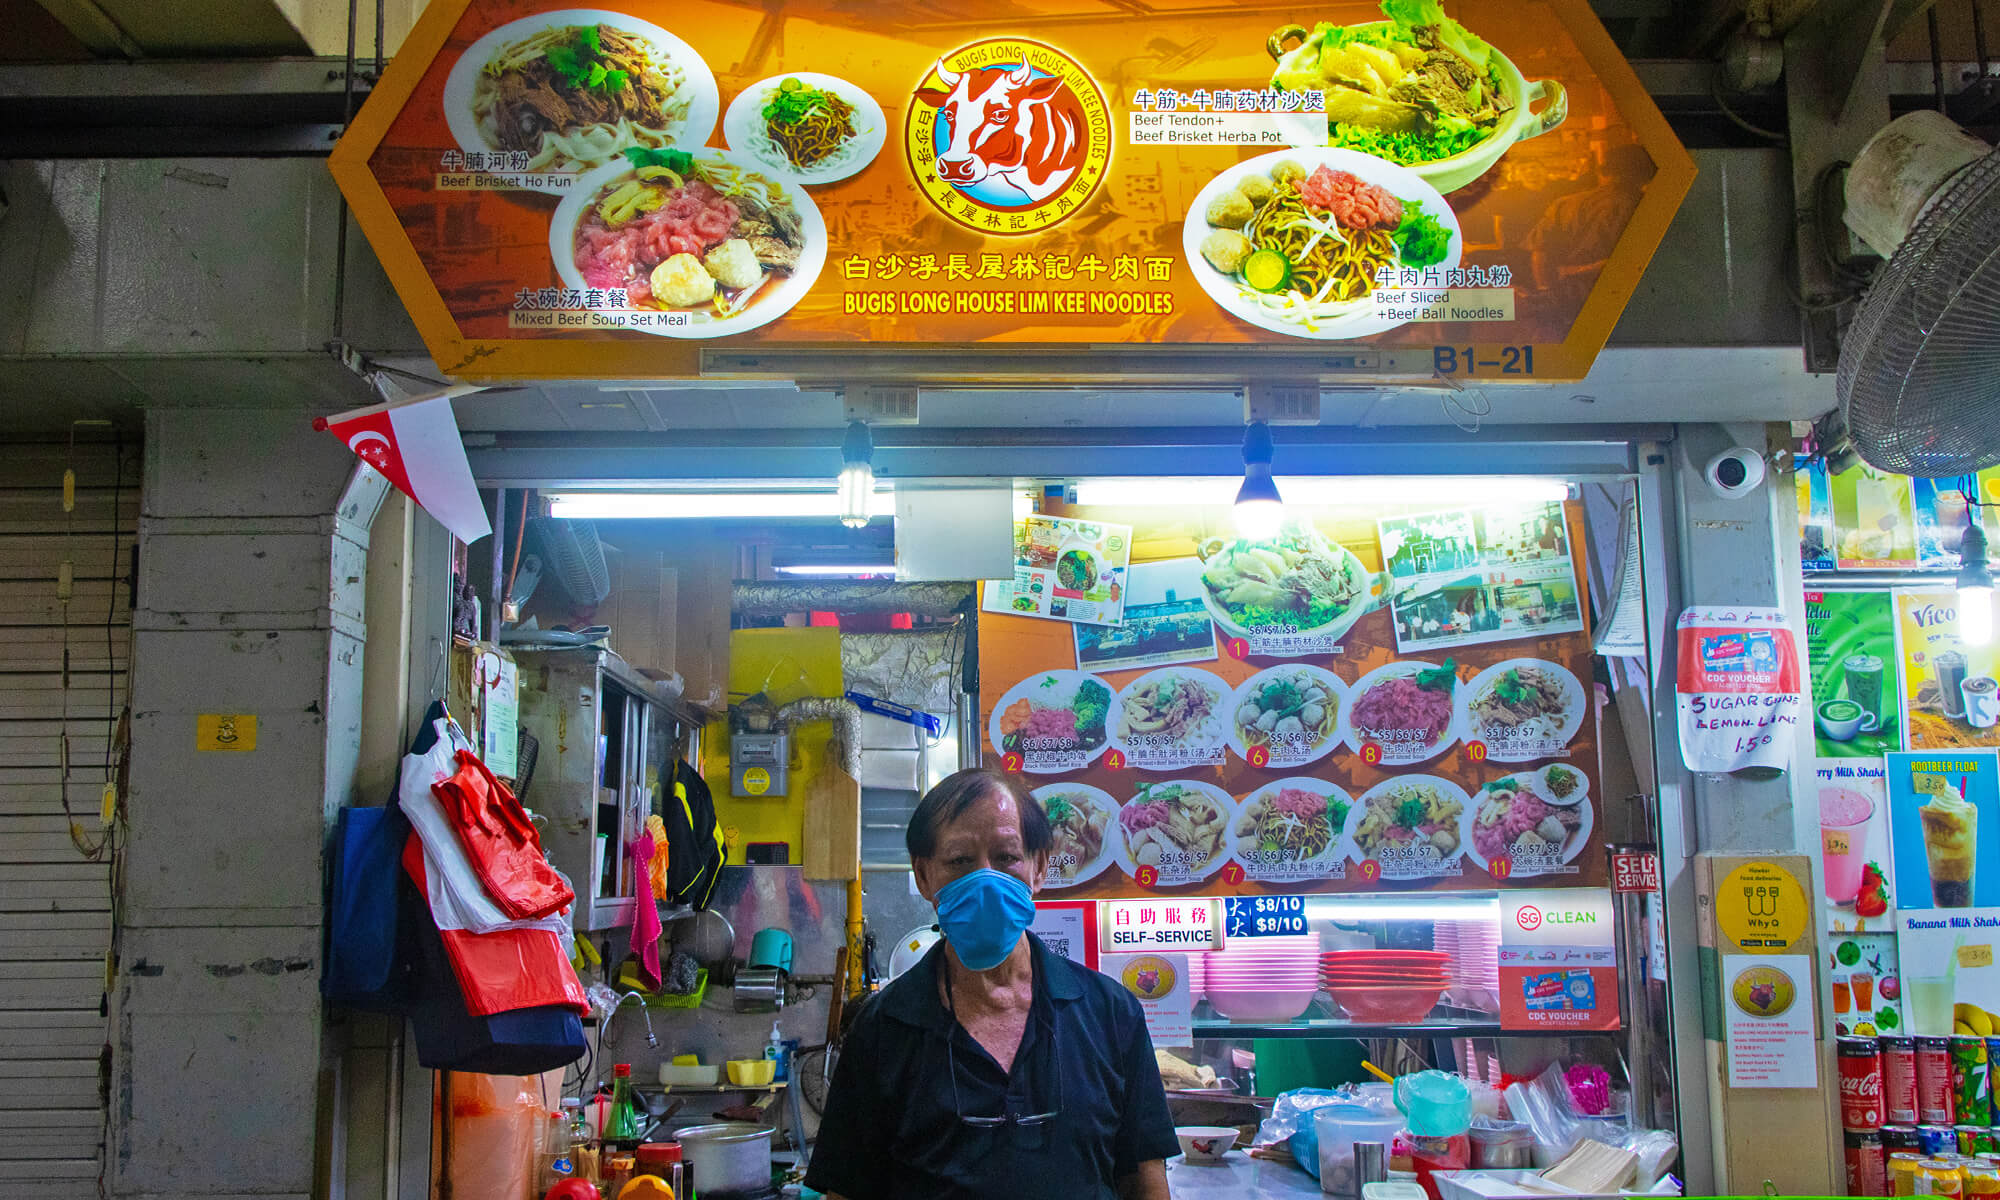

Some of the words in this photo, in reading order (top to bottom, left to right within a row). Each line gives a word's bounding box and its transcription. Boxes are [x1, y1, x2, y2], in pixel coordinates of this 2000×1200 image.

[956, 49, 988, 71] BUGIS
[990, 45, 1021, 59] LONG
[1031, 50, 1067, 74] HOUSE
[1066, 71, 1085, 89] LIM
[1079, 88, 1099, 111] KEE
[1089, 109, 1107, 160] NOODLES
[1135, 114, 1163, 126] Beef
[1168, 115, 1224, 126] Tendon+
[1135, 130, 1163, 142] Beef
[1168, 131, 1214, 142] Brisket
[1218, 131, 1257, 142] Herba
[1261, 131, 1282, 142] Pot
[441, 151, 529, 170] 牛腩河粉
[441, 175, 471, 187] Beef
[475, 175, 520, 187] Brisket
[525, 175, 543, 187] Ho
[547, 174, 571, 187] Fun
[1377, 266, 1512, 287] 牛肉片肉丸粉
[515, 288, 627, 308] 大碗汤套餐
[844, 292, 896, 314] BUGIS
[901, 292, 951, 313] LONG
[955, 292, 1016, 313] HOUSE
[1019, 292, 1049, 313] LIM
[1053, 292, 1085, 313] KEE
[1090, 292, 1174, 314] NOODLES
[1377, 292, 1406, 303] Beef
[1410, 291, 1450, 303] Sliced
[515, 314, 552, 326] Mixed
[558, 313, 588, 325] Beef
[592, 313, 626, 328] Soup
[631, 314, 652, 325] Set
[658, 313, 688, 325] Meal
[1378, 308, 1417, 320] +Beef
[1422, 308, 1446, 319] Ball
[1451, 308, 1504, 319] Noodles
[1912, 603, 1956, 627] Vico
[1233, 640, 1240, 657] 1
[1707, 674, 1726, 682] CDC
[1728, 674, 1771, 683] VOUCHER
[1691, 695, 1758, 714] SUGAR
[1307, 732, 1319, 741] $7
[1415, 729, 1427, 739] $7
[1523, 727, 1535, 736] $7
[1060, 737, 1072, 748] $8
[1164, 736, 1176, 744] $7
[1253, 750, 1263, 766] 6
[1366, 746, 1376, 762] 8
[1467, 744, 1484, 760] 10
[1007, 755, 1017, 771] 2
[1109, 753, 1119, 768] 4
[1911, 761, 1953, 772] ROOTBEER
[1955, 761, 1978, 772] FLOAT
[1834, 766, 1855, 778] Milk
[1283, 850, 1295, 859] $7
[1420, 847, 1431, 856] $7
[1547, 844, 1560, 853] $8
[1064, 855, 1076, 865] $8
[1196, 852, 1208, 862] $7
[1228, 867, 1238, 882] 7
[1364, 863, 1374, 880] 9
[1492, 860, 1506, 876] 11
[1141, 869, 1151, 885] 5
[1230, 898, 1247, 917] 大
[1255, 897, 1301, 914] $8/10
[1116, 907, 1207, 926] 自助服務
[1520, 912, 1539, 924] SG
[1546, 911, 1596, 924] CLEAN
[1907, 917, 1947, 929] Banana
[1949, 916, 1971, 928] Milk
[1231, 918, 1248, 937] 大
[1256, 916, 1303, 933] $8/10
[1113, 930, 1213, 944] SELF-SERVICE
[1528, 1012, 1546, 1021] CDC
[1548, 1012, 1590, 1021] VOUCHER
